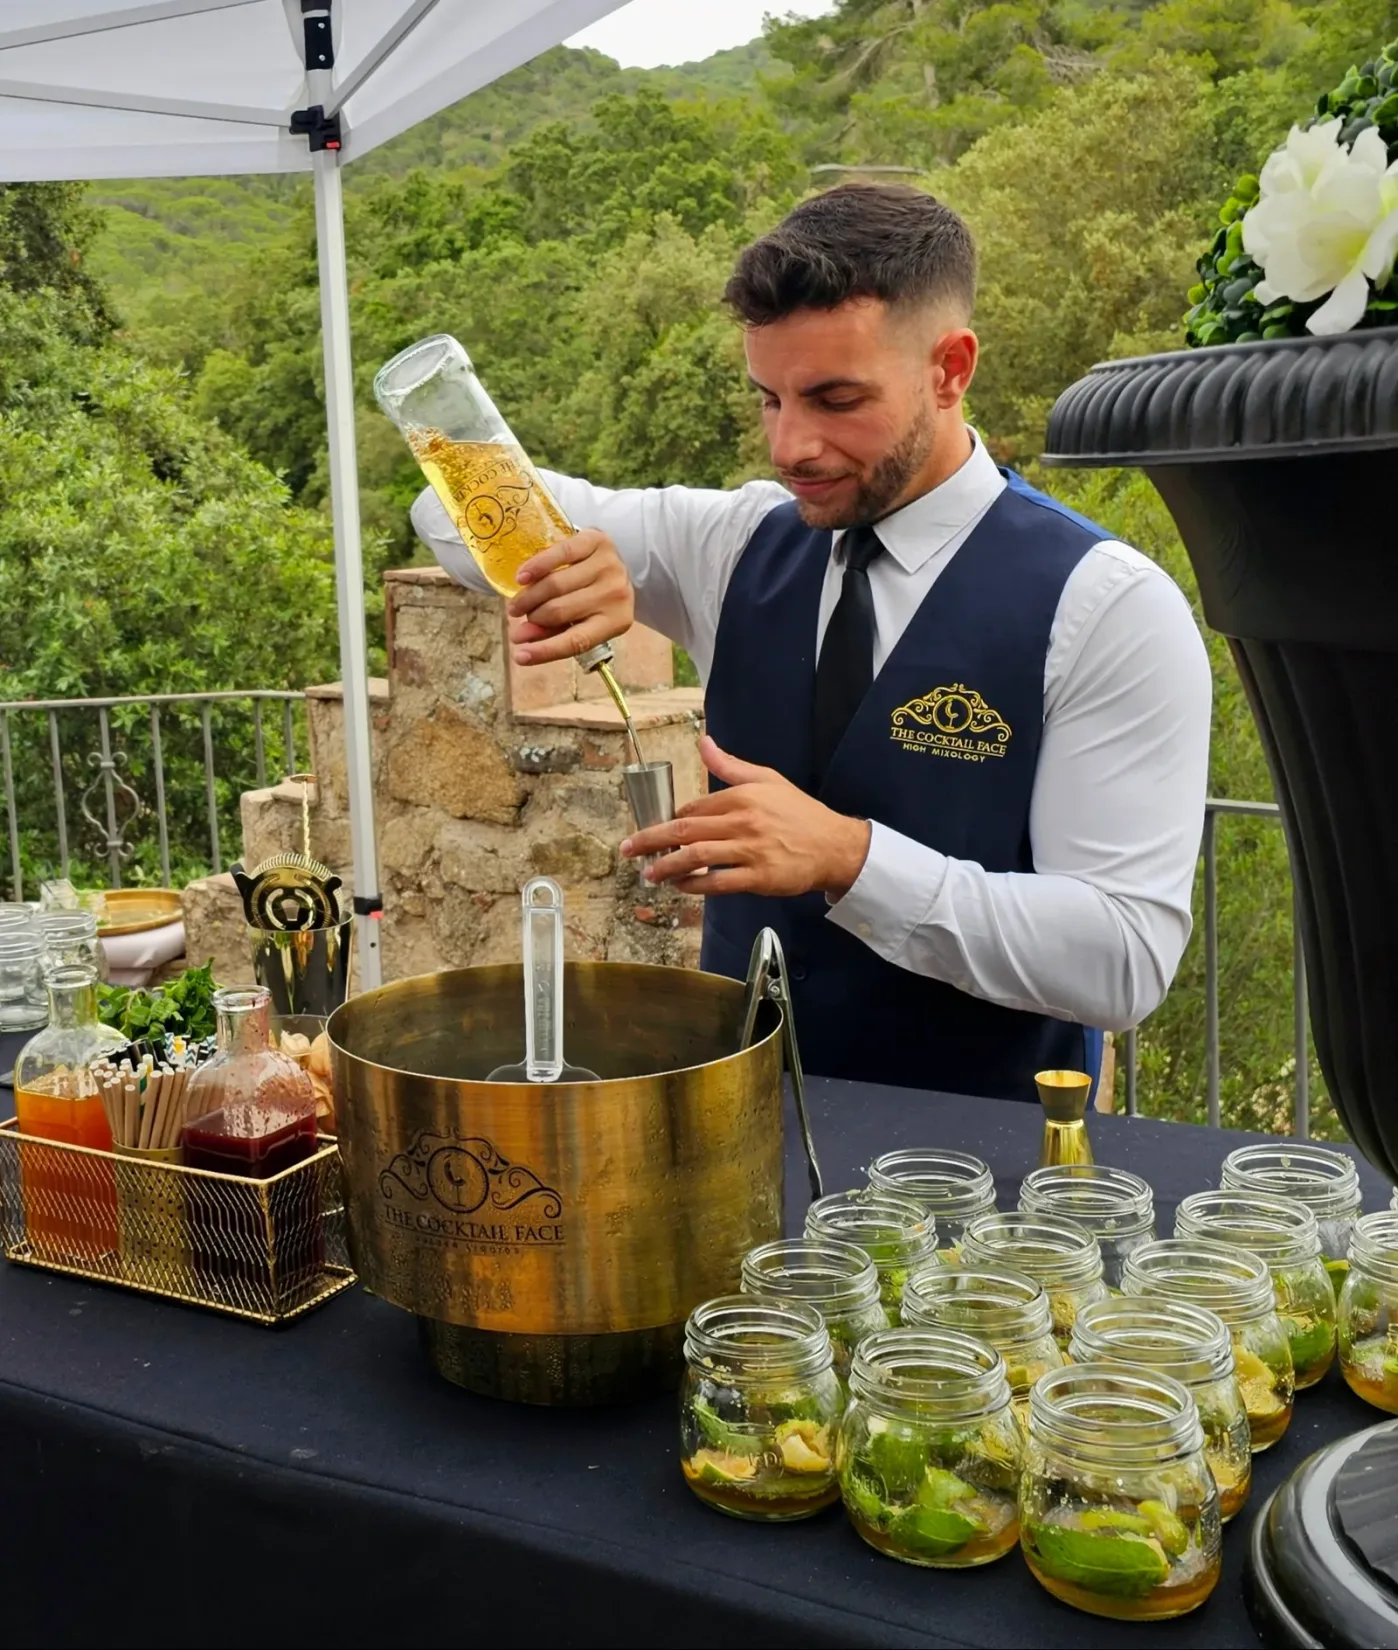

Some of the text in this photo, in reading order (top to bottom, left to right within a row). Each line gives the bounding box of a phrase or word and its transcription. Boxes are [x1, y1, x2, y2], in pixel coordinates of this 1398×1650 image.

[891, 726, 1007, 755] THE COCKTAIL FACE
[902, 742, 986, 763] HIGH MIXOLOGY
[385, 1204, 565, 1241] THE COCKTAIL FACE
